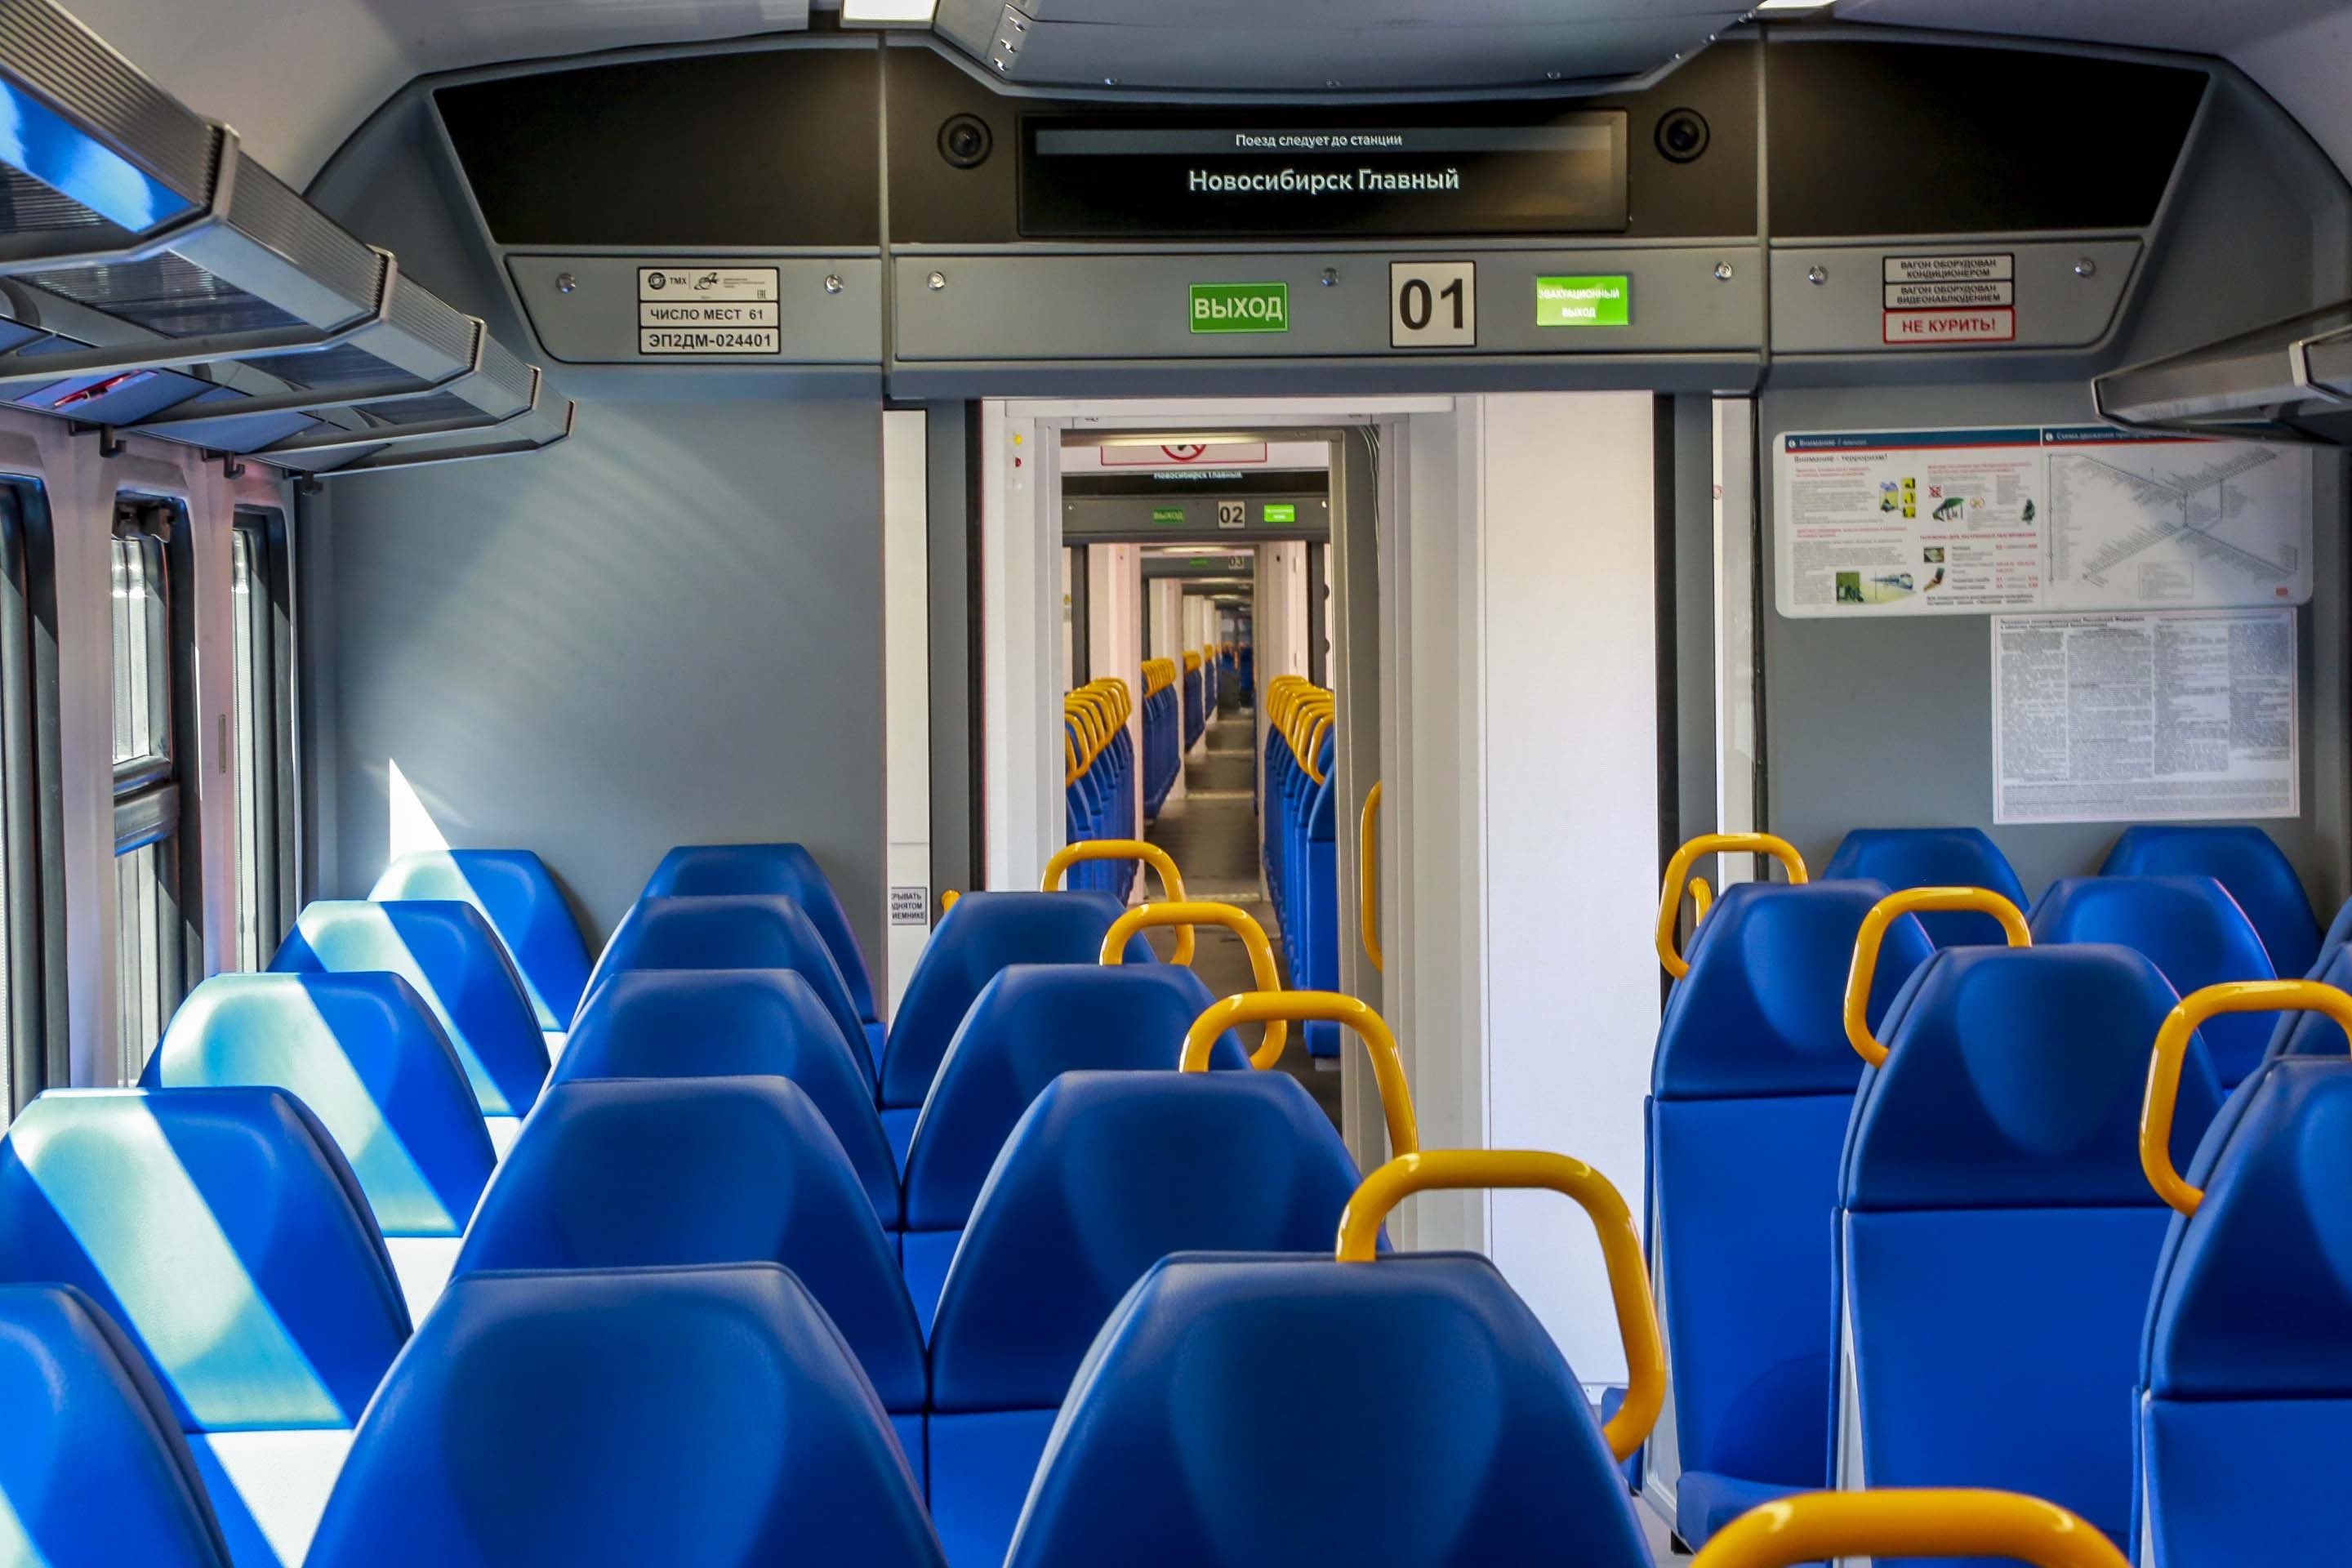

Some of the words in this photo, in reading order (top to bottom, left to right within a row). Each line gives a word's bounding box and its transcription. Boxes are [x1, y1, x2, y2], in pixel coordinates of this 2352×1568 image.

[1236, 134, 1276, 148] Поезд
[1279, 136, 1330, 149] следует
[1331, 136, 1348, 147] до
[1350, 135, 1402, 147] станции
[1189, 168, 1353, 195] Новосибирск
[1358, 168, 1460, 190] Главный
[1900, 261, 1931, 270] ВАГОН
[1933, 259, 1997, 269] ОБОРУДОВАН
[1907, 269, 1990, 279] КОНДИЦИОНЕРОМ
[1901, 286, 1931, 295] ВАГОН
[1934, 284, 1997, 294] ОБОРУДОВАН
[1399, 278, 1464, 330] 01
[1896, 294, 2001, 305] ВИДЕОНАБЛЮДЕНИЕМ
[650, 309, 699, 320] ЧИСЛО
[704, 310, 742, 320] МЕСТ
[749, 310, 764, 319] 61
[1194, 296, 1283, 322] ВЫХОД
[1561, 307, 1597, 318] ВЫХОД
[1902, 320, 1923, 333] НЕ
[1929, 318, 1996, 333] КУРИТЬ!
[649, 333, 771, 350] ЭП2ДМ-024401
[1219, 506, 1244, 523] 02
